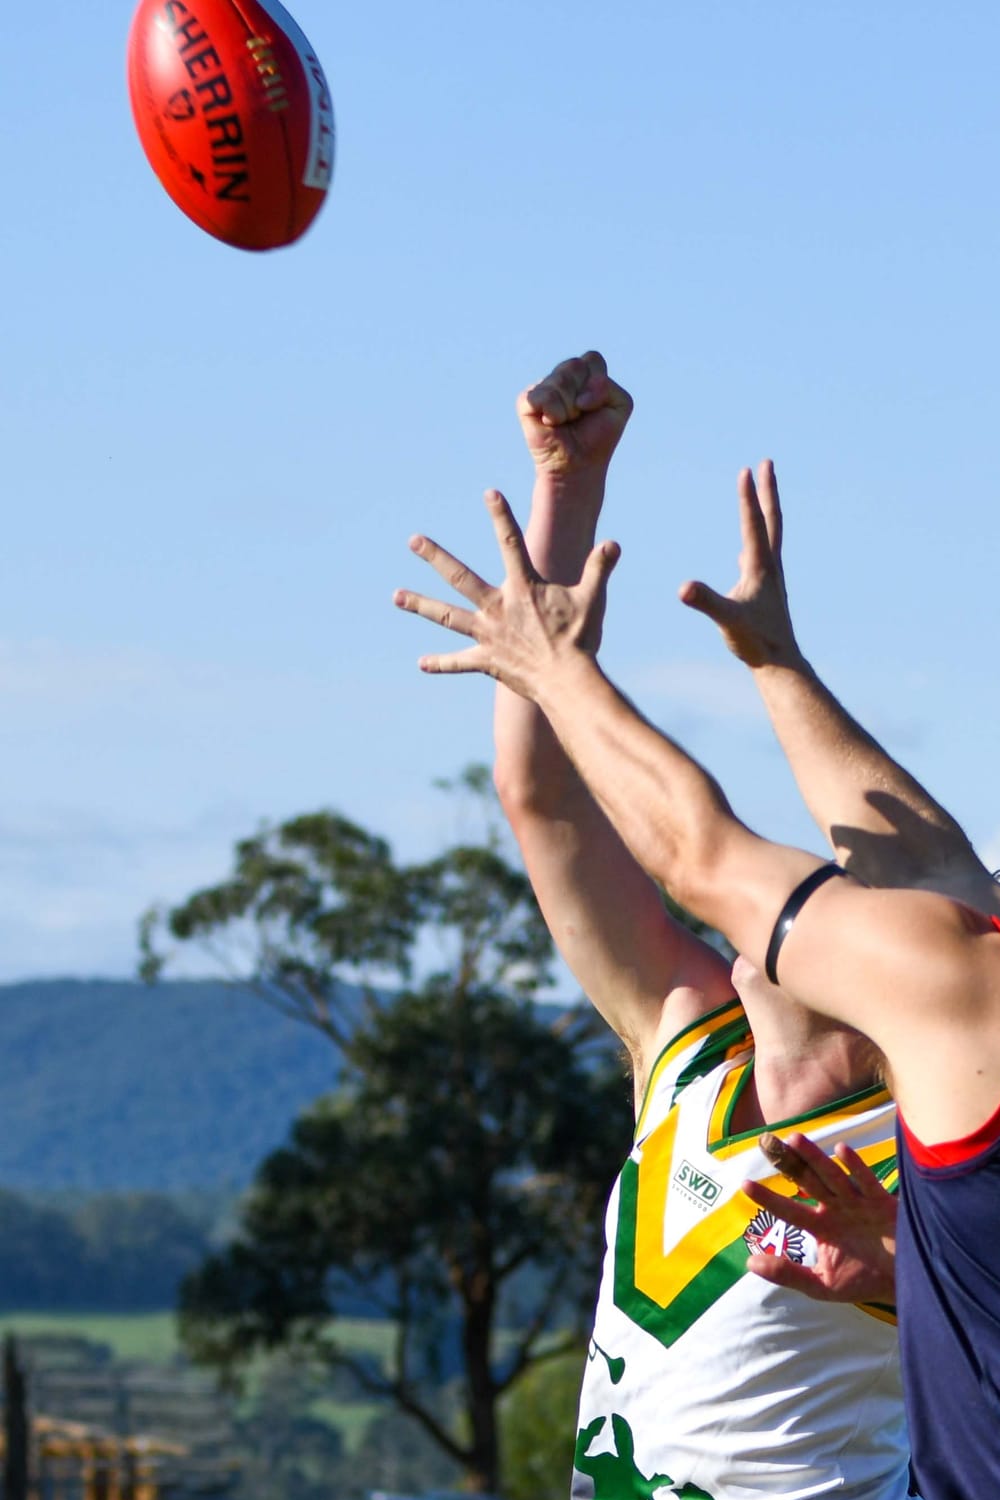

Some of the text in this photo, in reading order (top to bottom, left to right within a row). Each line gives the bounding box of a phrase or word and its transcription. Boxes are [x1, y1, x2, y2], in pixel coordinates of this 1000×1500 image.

[161, 0, 250, 203] SHERRIN
[678, 1165, 718, 1200] SWD
[759, 1218, 787, 1257] A
